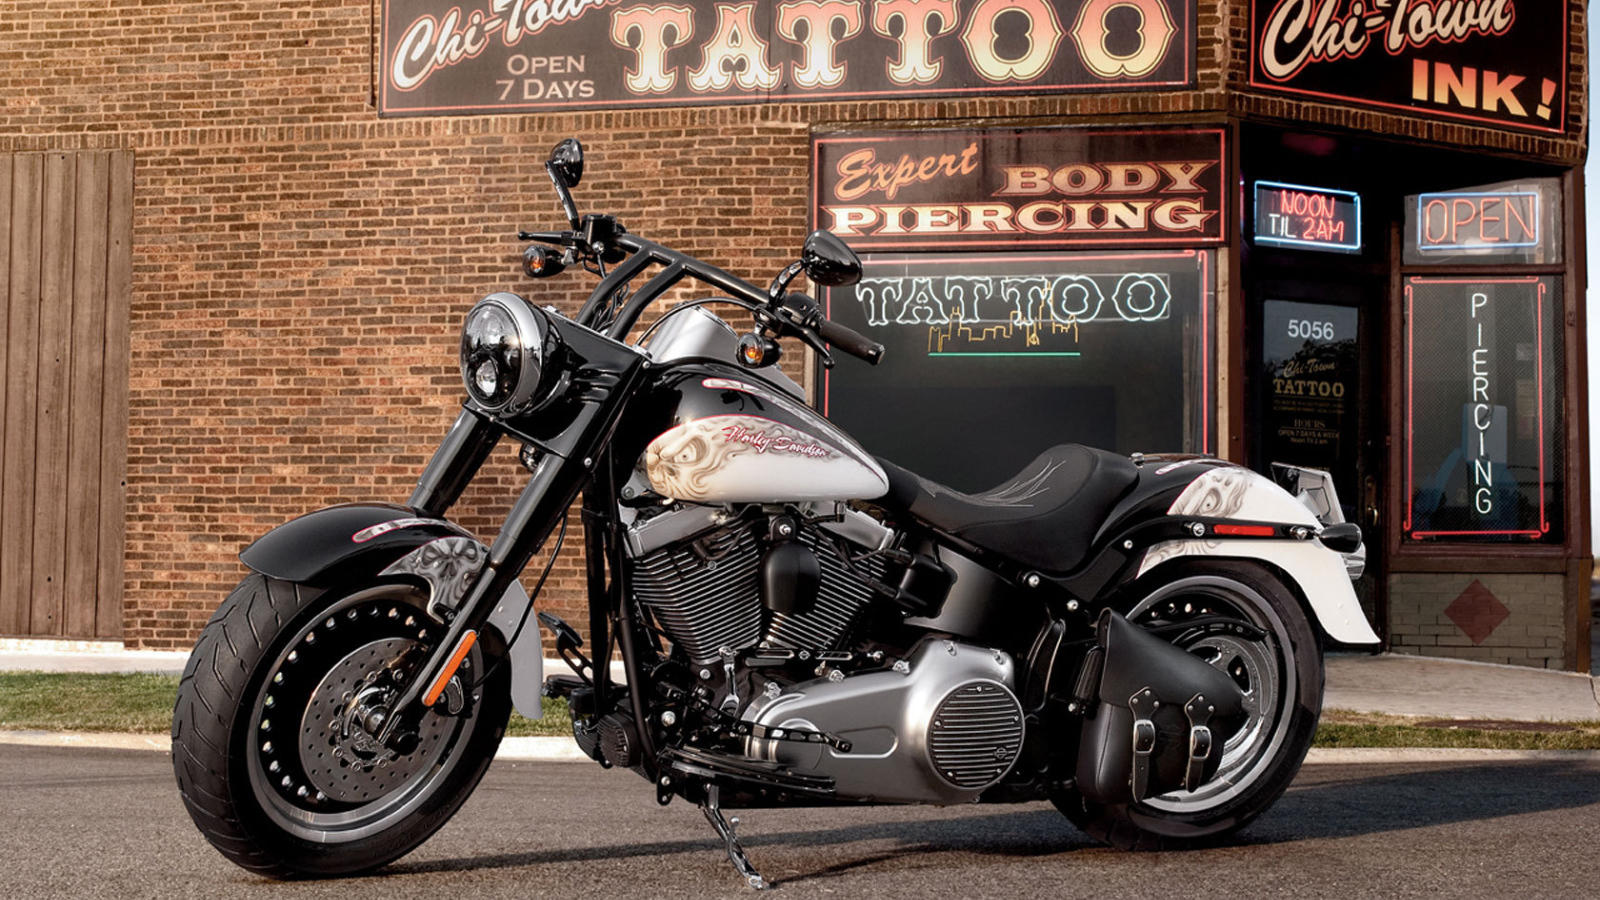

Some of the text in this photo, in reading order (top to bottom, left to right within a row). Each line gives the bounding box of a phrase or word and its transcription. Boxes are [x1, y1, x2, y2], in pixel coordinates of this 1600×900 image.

[392, 0, 618, 89] Chi-Tow
[610, 0, 1179, 95] TATTOO
[1261, 0, 1514, 79] Chi-Town
[495, 80, 514, 101] 7
[835, 142, 979, 199] Expert
[995, 160, 1218, 196] BODY
[821, 199, 1217, 236] PIERCING
[1280, 190, 1335, 219] NOON
[1425, 195, 1535, 244] OPEN
[1268, 213, 1345, 242] TIL 2AM
[855, 273, 1172, 327] TATTOO
[1287, 319, 1334, 340] 5056
[1283, 358, 1336, 378] Chi-Town
[1272, 378, 1345, 397] TATTOO
[1471, 293, 1492, 514] PIERCING
